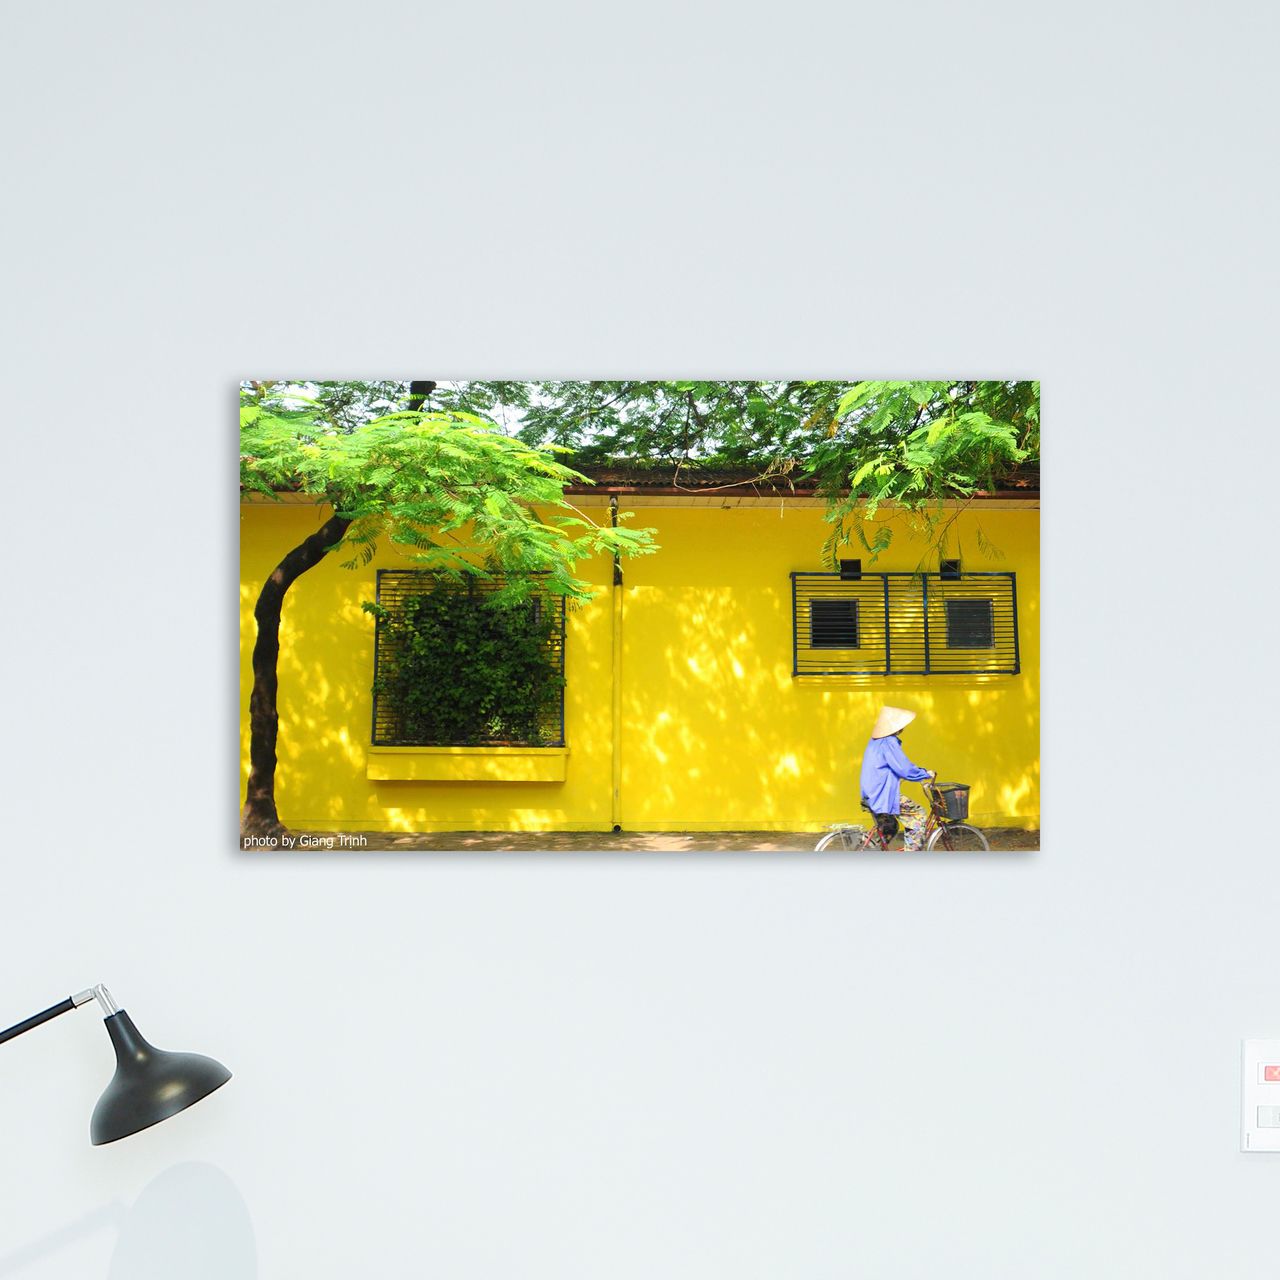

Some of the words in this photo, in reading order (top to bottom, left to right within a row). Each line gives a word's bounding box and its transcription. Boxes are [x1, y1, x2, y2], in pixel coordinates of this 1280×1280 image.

[243, 835, 278, 849] photo
[281, 835, 296, 849] by
[300, 835, 334, 849] Giang
